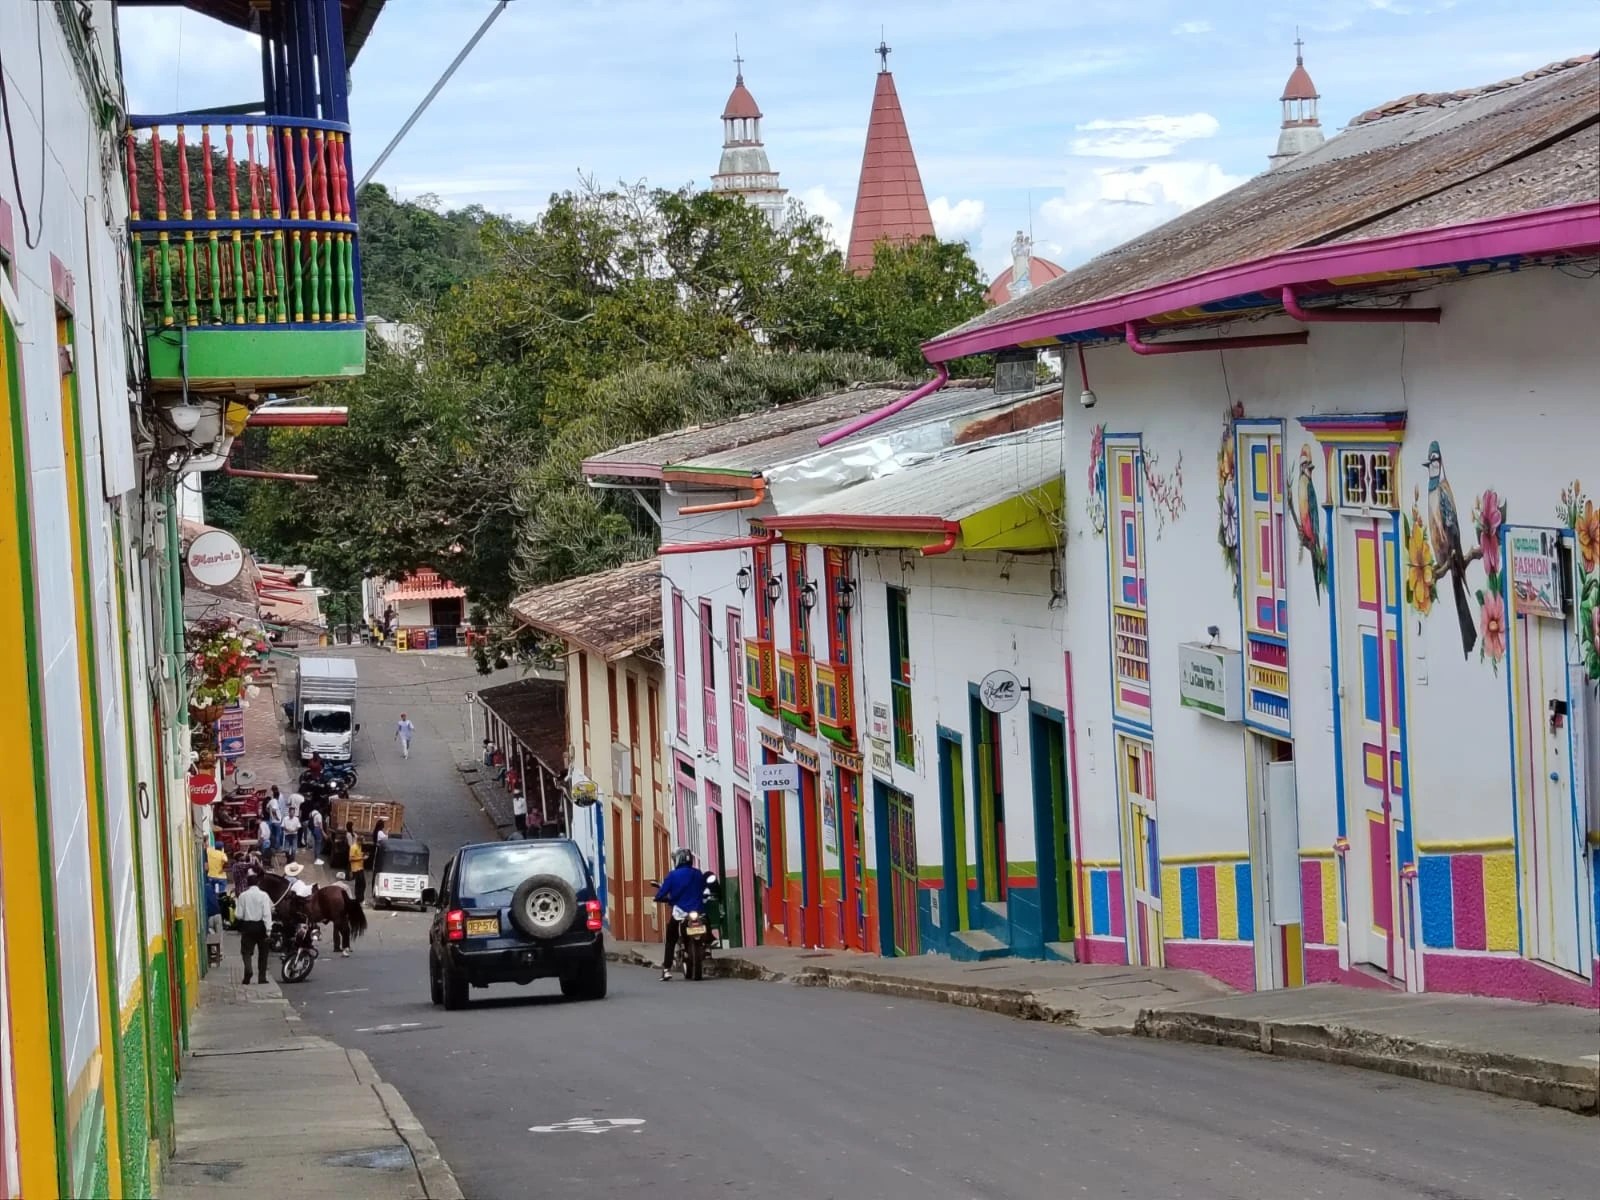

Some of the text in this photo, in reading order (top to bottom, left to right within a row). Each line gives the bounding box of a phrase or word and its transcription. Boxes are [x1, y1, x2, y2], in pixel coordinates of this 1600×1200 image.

[190, 549, 240, 567] Maria's
[1514, 556, 1549, 576] FASHION
[761, 779, 790, 787] OCASO
